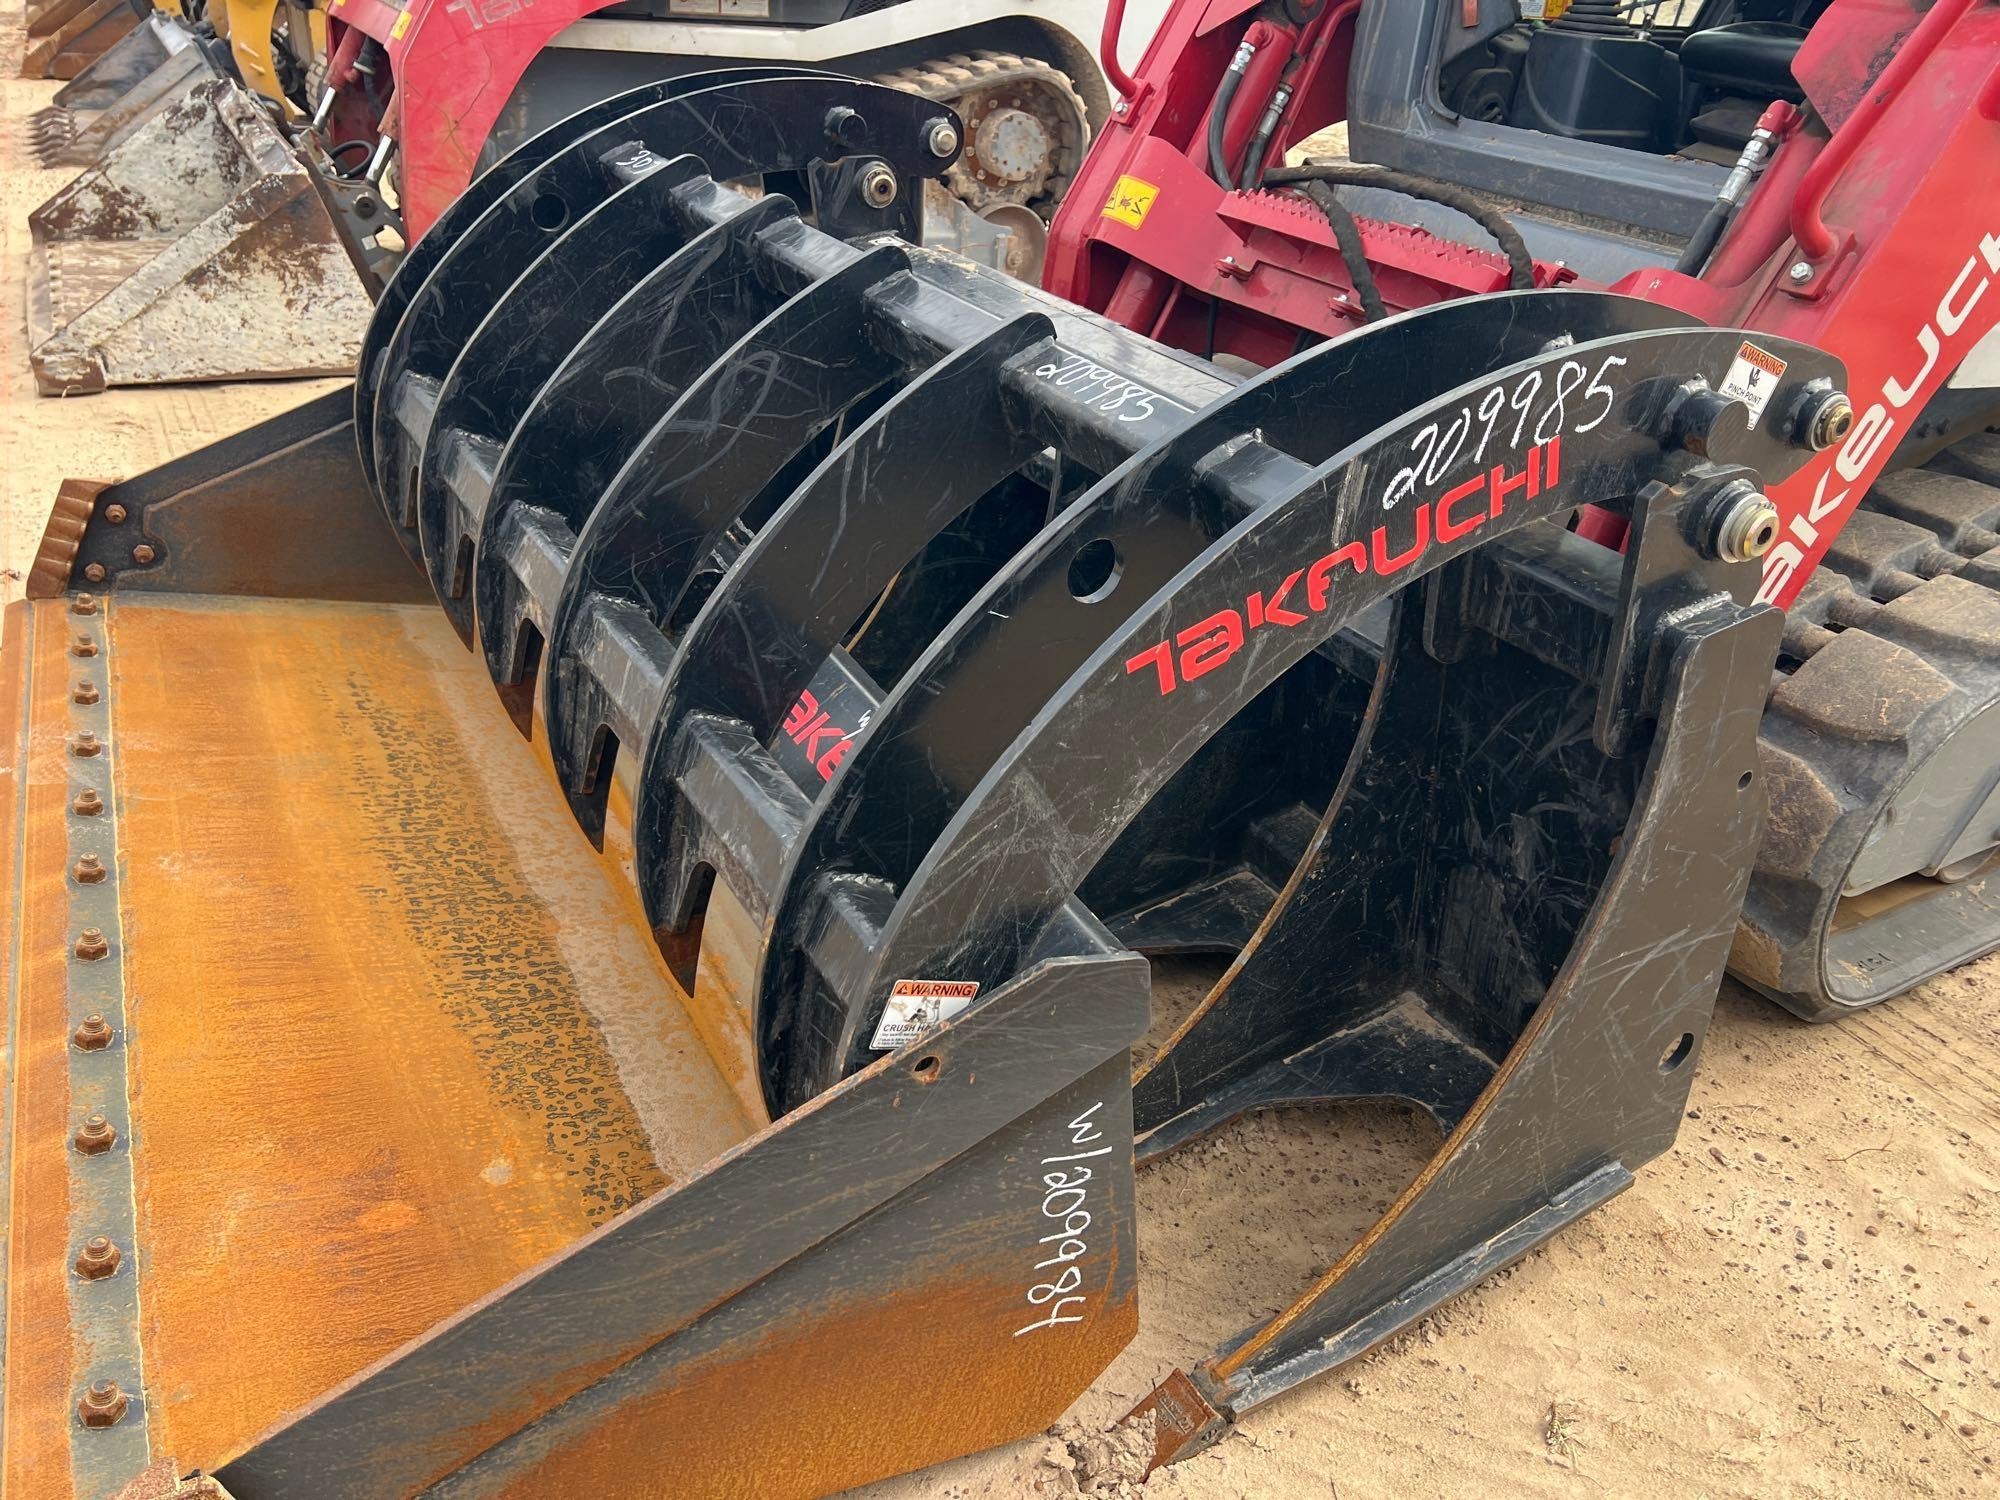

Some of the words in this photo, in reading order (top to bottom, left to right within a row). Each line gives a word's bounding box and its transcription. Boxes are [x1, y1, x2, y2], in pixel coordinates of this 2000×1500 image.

[1745, 347, 1784, 376] WARNING
[1036, 355, 1158, 421] 209985
[1728, 382, 1746, 397] PINCH
[1744, 391, 1762, 405] POINT
[1382, 356, 1627, 510] 209985
[910, 984, 973, 996] WARNING
[883, 1024, 916, 1032] CRUSH
